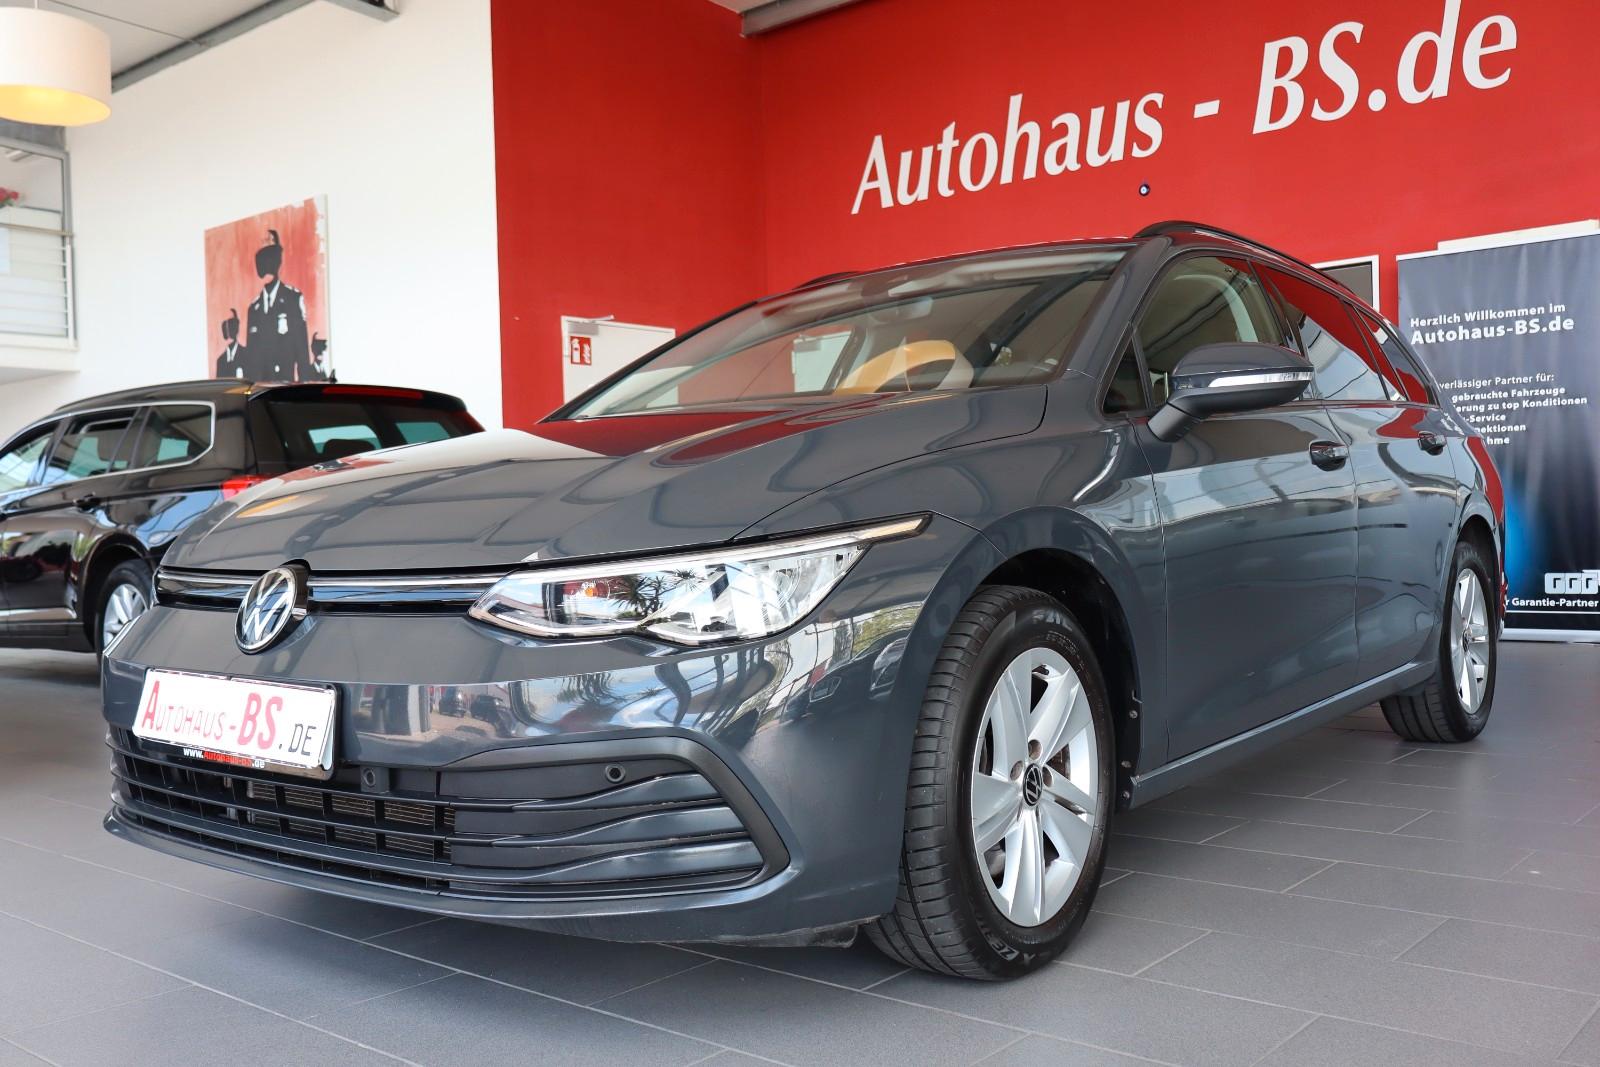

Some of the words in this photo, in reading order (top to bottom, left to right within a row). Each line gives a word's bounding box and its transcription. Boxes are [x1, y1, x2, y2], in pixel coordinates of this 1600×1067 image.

[851, 93, 1164, 215] Autohaus
[1252, 0, 1517, 134] BS.de
[1410, 313, 1461, 328] Herzlich
[1464, 305, 1545, 322] Willkommen
[1549, 303, 1566, 313] im
[1410, 316, 1575, 345] Autohaus-BS.de
[1495, 374, 1533, 386] Partner
[1536, 373, 1555, 383] für:
[1452, 390, 1509, 403] gebrauchte
[1511, 387, 1566, 399] Fahrzeuge
[1502, 401, 1520, 411] top
[1522, 397, 1588, 409] Konditionen
[1511, 597, 1599, 608] Garantie-Partner
